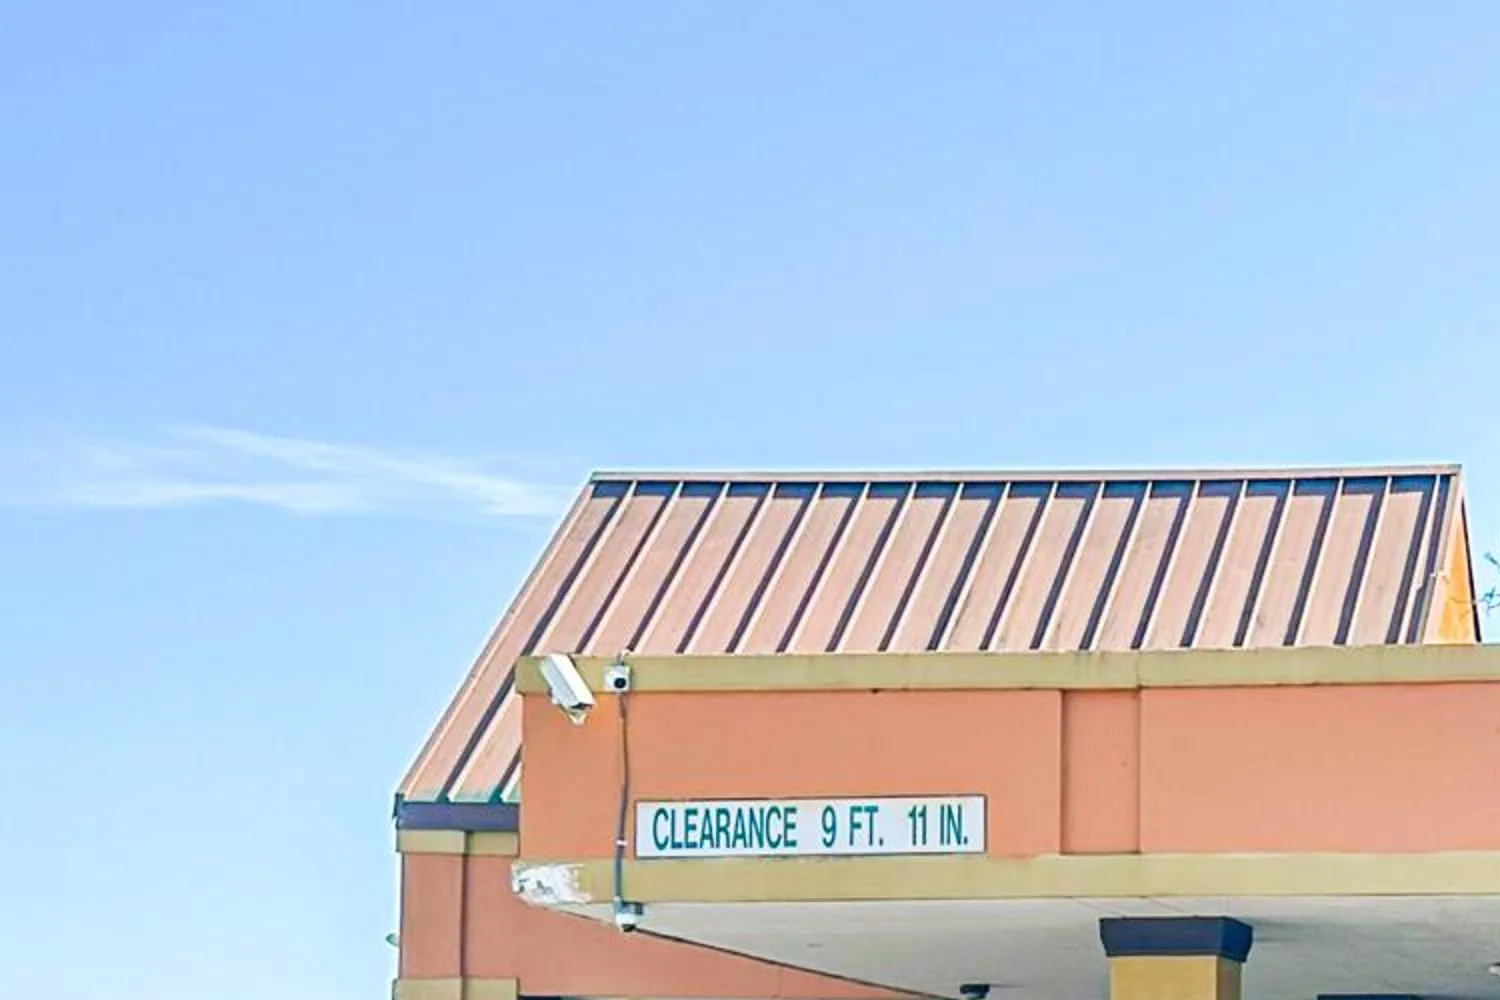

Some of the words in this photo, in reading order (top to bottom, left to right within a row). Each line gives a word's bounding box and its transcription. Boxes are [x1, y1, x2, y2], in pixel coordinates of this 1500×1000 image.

[653, 806, 798, 851] CLEARANCE
[821, 805, 837, 848] 9
[849, 805, 884, 847] FT.
[908, 804, 928, 846] 11
[939, 803, 969, 846] IN.
